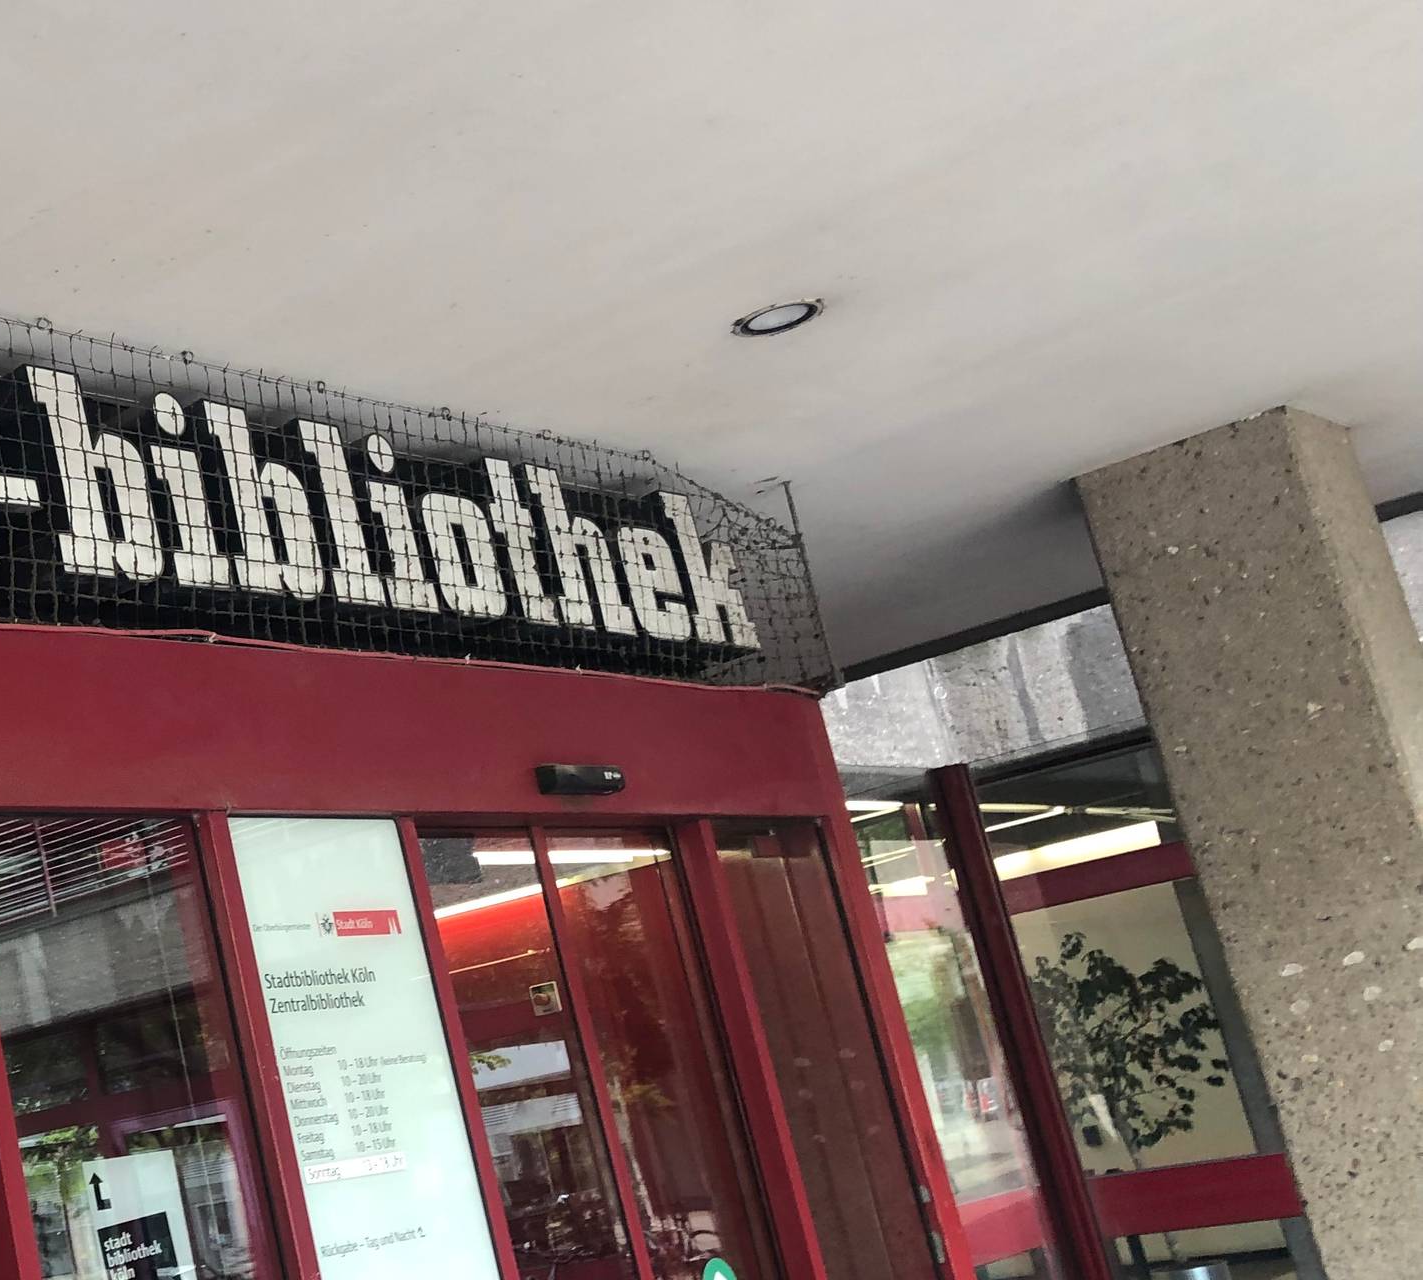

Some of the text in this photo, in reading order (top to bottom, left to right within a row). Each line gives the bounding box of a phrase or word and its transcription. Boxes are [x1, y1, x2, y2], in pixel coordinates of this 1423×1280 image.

[336, 917, 374, 930] Stadt Köln
[264, 966, 376, 989] Stadtbibliothek Köln
[269, 990, 365, 1014] Zentralbibliothek
[279, 1045, 337, 1060] Öffnungszeiten
[283, 1065, 314, 1077] Montag
[286, 1081, 321, 1094] Dienstag
[290, 1095, 328, 1110] Mittwoch
[293, 1113, 339, 1127] Donnerstag
[297, 1132, 325, 1145] Freitag
[301, 1148, 335, 1162] Samstag
[103, 1231, 133, 1252] stadt
[106, 1240, 163, 1268] bibliothek
